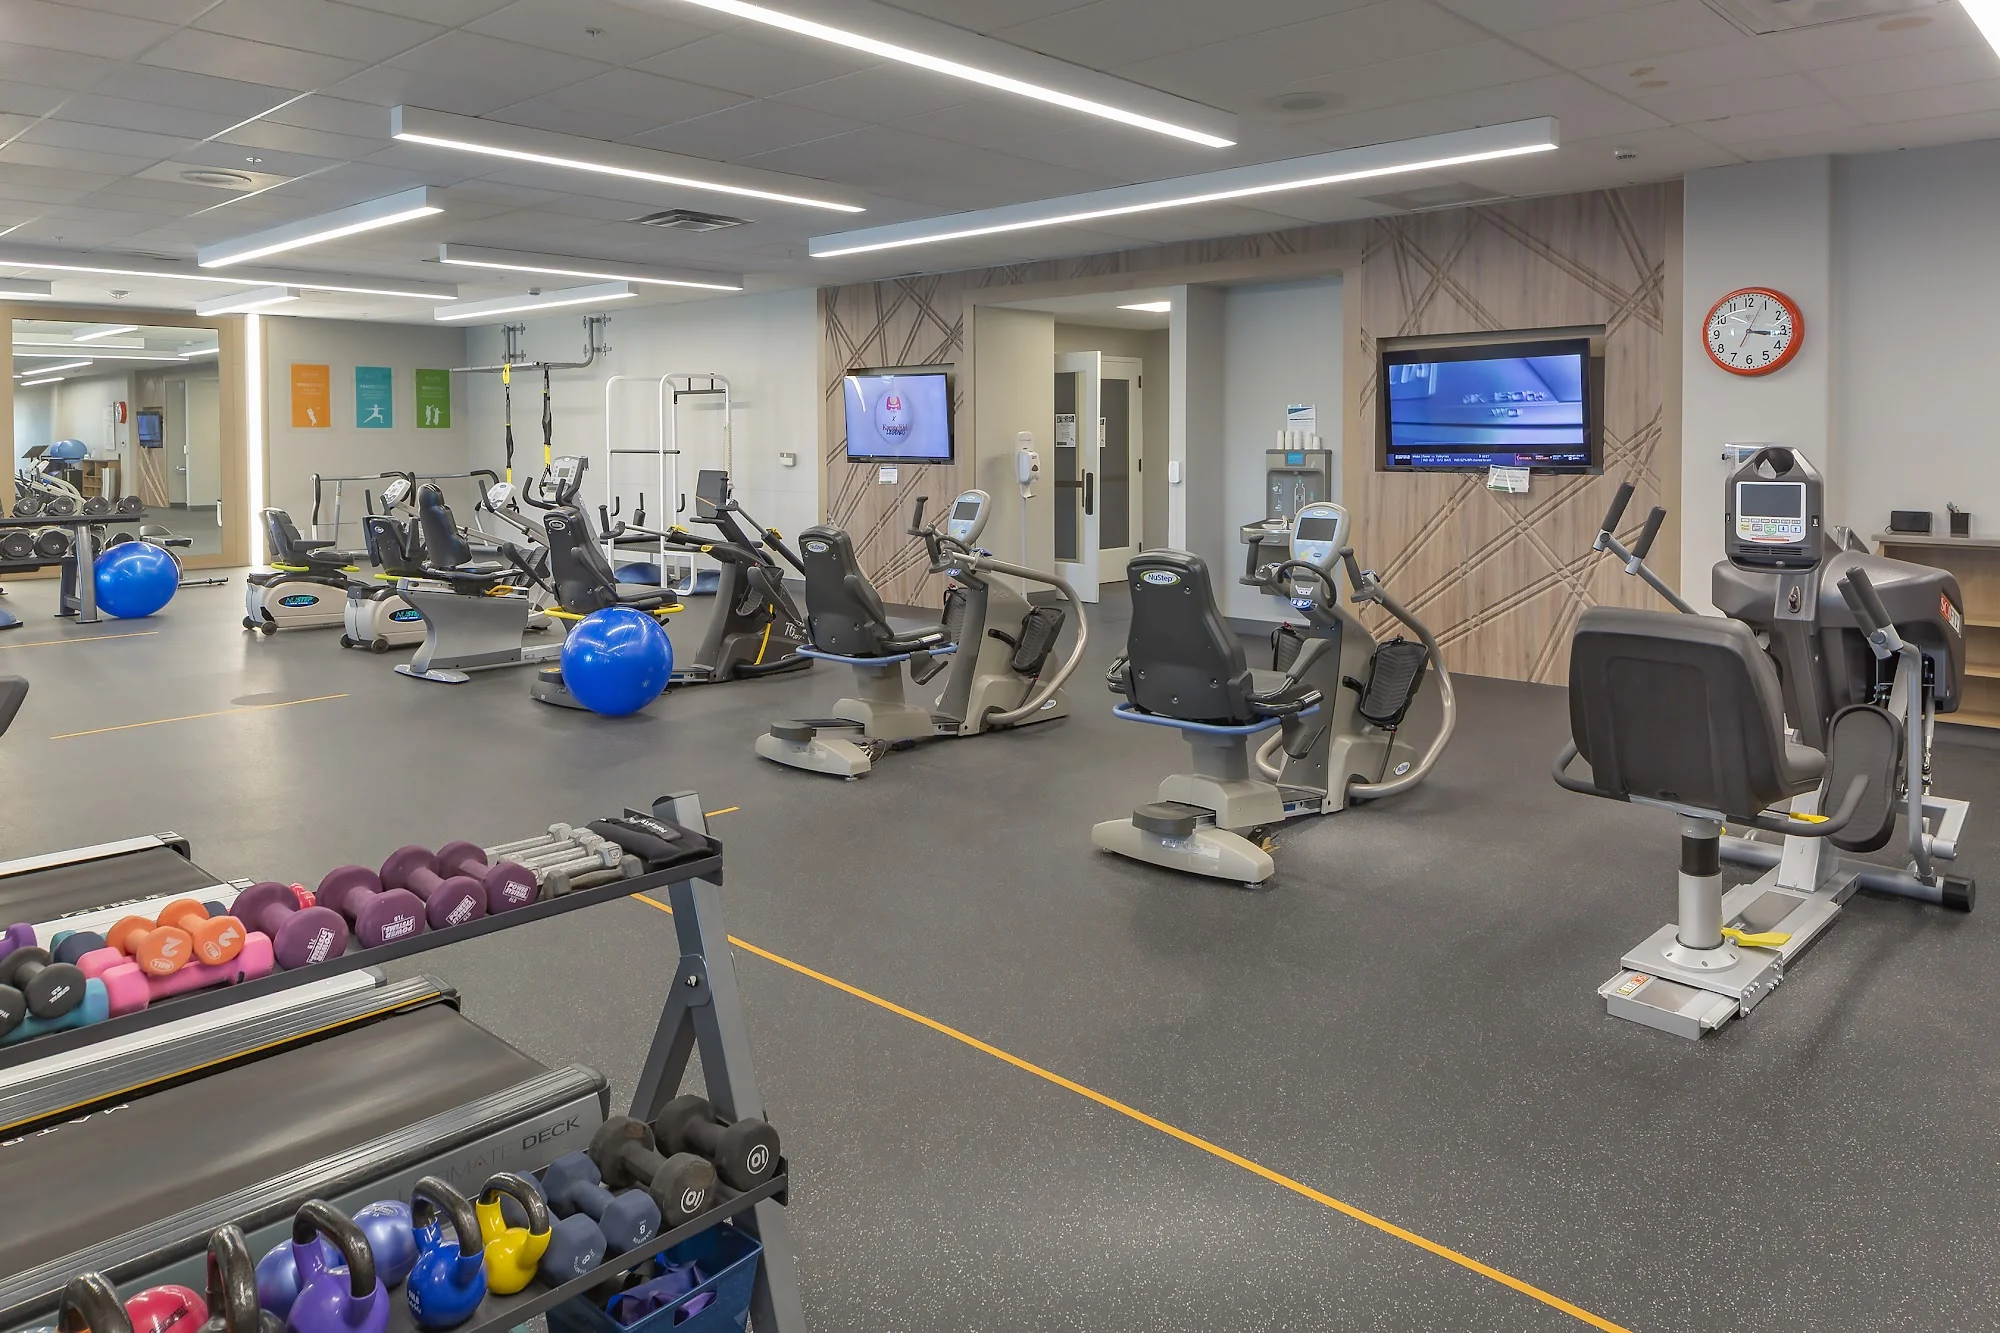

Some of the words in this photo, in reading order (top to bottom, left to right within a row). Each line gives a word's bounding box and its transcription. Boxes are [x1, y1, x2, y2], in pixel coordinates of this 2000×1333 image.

[1729, 303, 1736, 312] 11
[1745, 297, 1754, 308] 12
[1717, 314, 1727, 325] 10
[1775, 310, 1782, 321] 2
[1713, 330, 1720, 340] 9
[1780, 325, 1787, 335] 3
[1717, 343, 1725, 353] 8
[1773, 340, 1782, 350] 4
[1730, 352, 1738, 362] 7
[1745, 354, 1753, 365] 6
[1762, 351, 1770, 361] 5
[1148, 574, 1173, 583] NuStep
[507, 882, 529, 893] POWER
[218, 926, 240, 947] 2
[385, 926, 413, 939] POWER
[161, 936, 183, 957] 2
[522, 1115, 580, 1151] DECK
[751, 1149, 765, 1168] 10
[685, 1190, 702, 1207] 10
[639, 1224, 646, 1235] 8
[582, 1254, 591, 1265] 8
